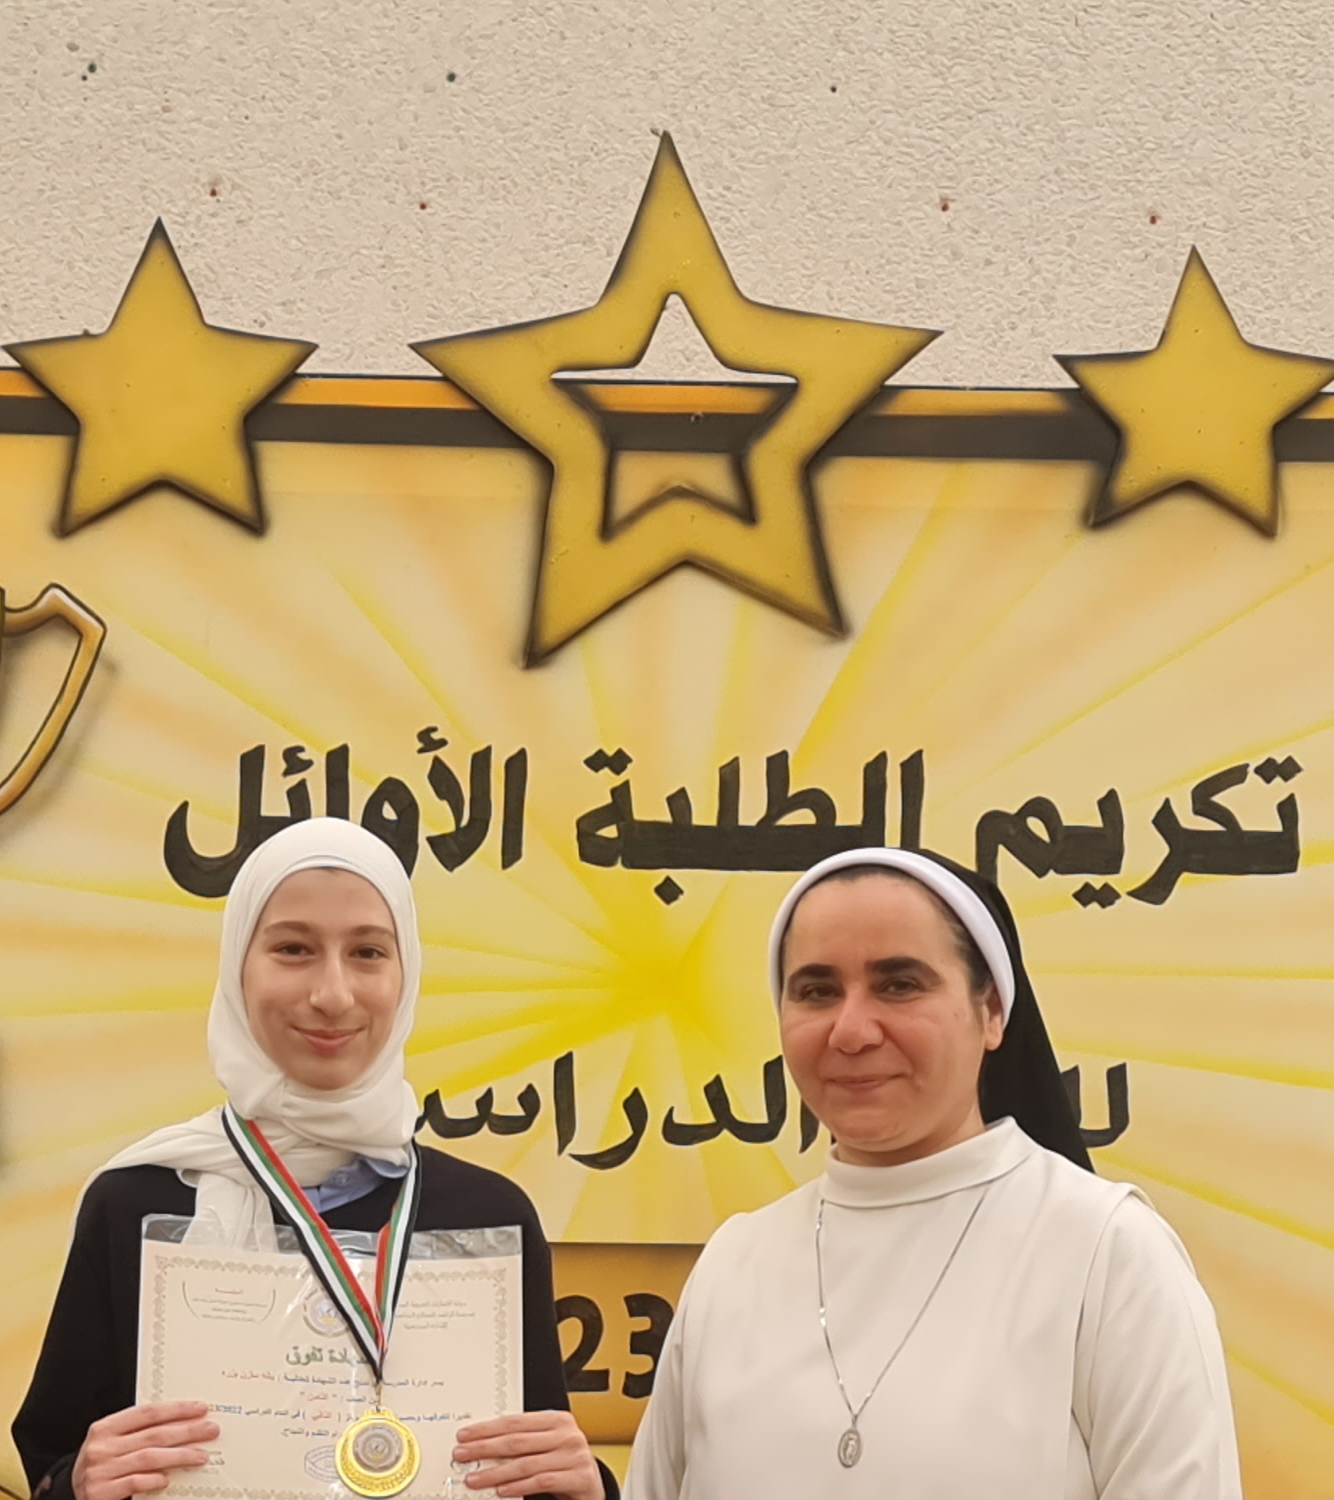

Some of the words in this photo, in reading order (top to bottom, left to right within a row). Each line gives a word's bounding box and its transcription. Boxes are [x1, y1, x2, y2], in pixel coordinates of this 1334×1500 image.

[576, 747, 925, 905] الطلبة
[975, 755, 1304, 910] تكريم
[414, 1050, 820, 1171] الدراس
